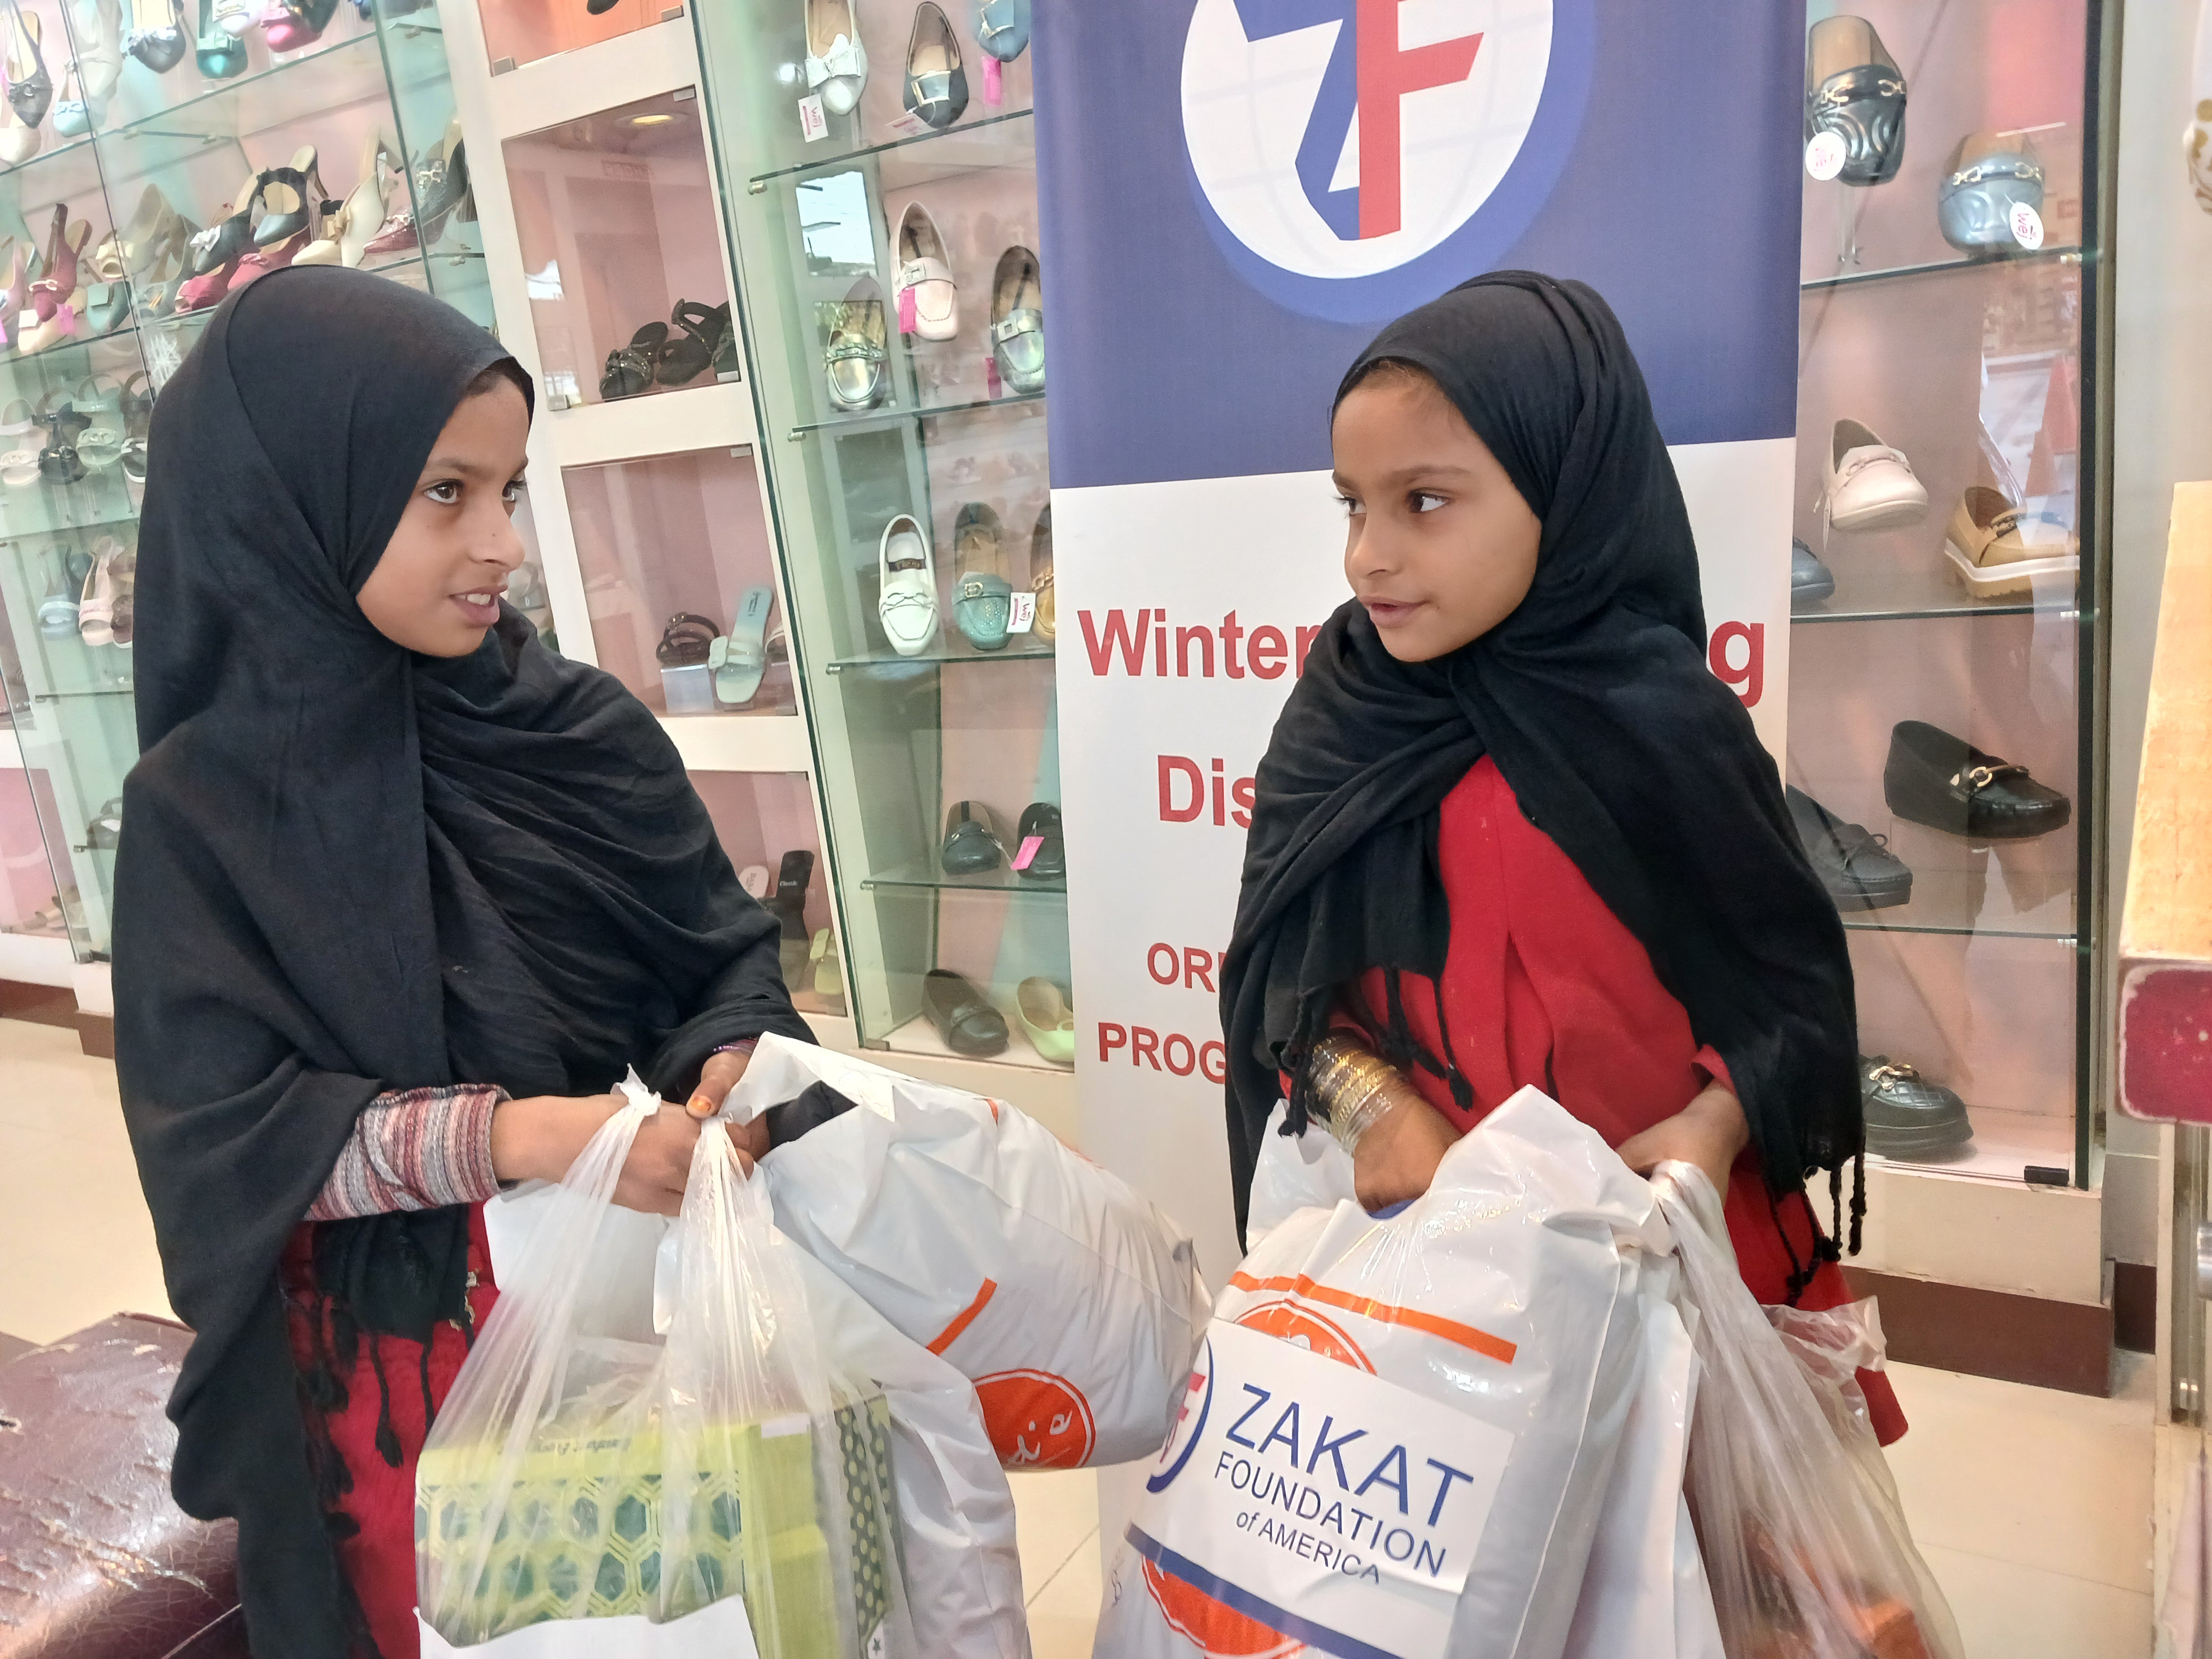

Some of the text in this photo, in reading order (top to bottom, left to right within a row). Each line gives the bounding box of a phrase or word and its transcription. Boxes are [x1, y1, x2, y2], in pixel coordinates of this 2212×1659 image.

[1077, 608, 1324, 680] Winter
[1158, 754, 1256, 829] Dis
[1147, 942, 1227, 993] OR
[1098, 1021, 1226, 1085] PROG
[1225, 1382, 1474, 1528] ZAKAT
[1214, 1450, 1446, 1578] FOUNDATION
[1236, 1511, 1380, 1585] of AMERICA
